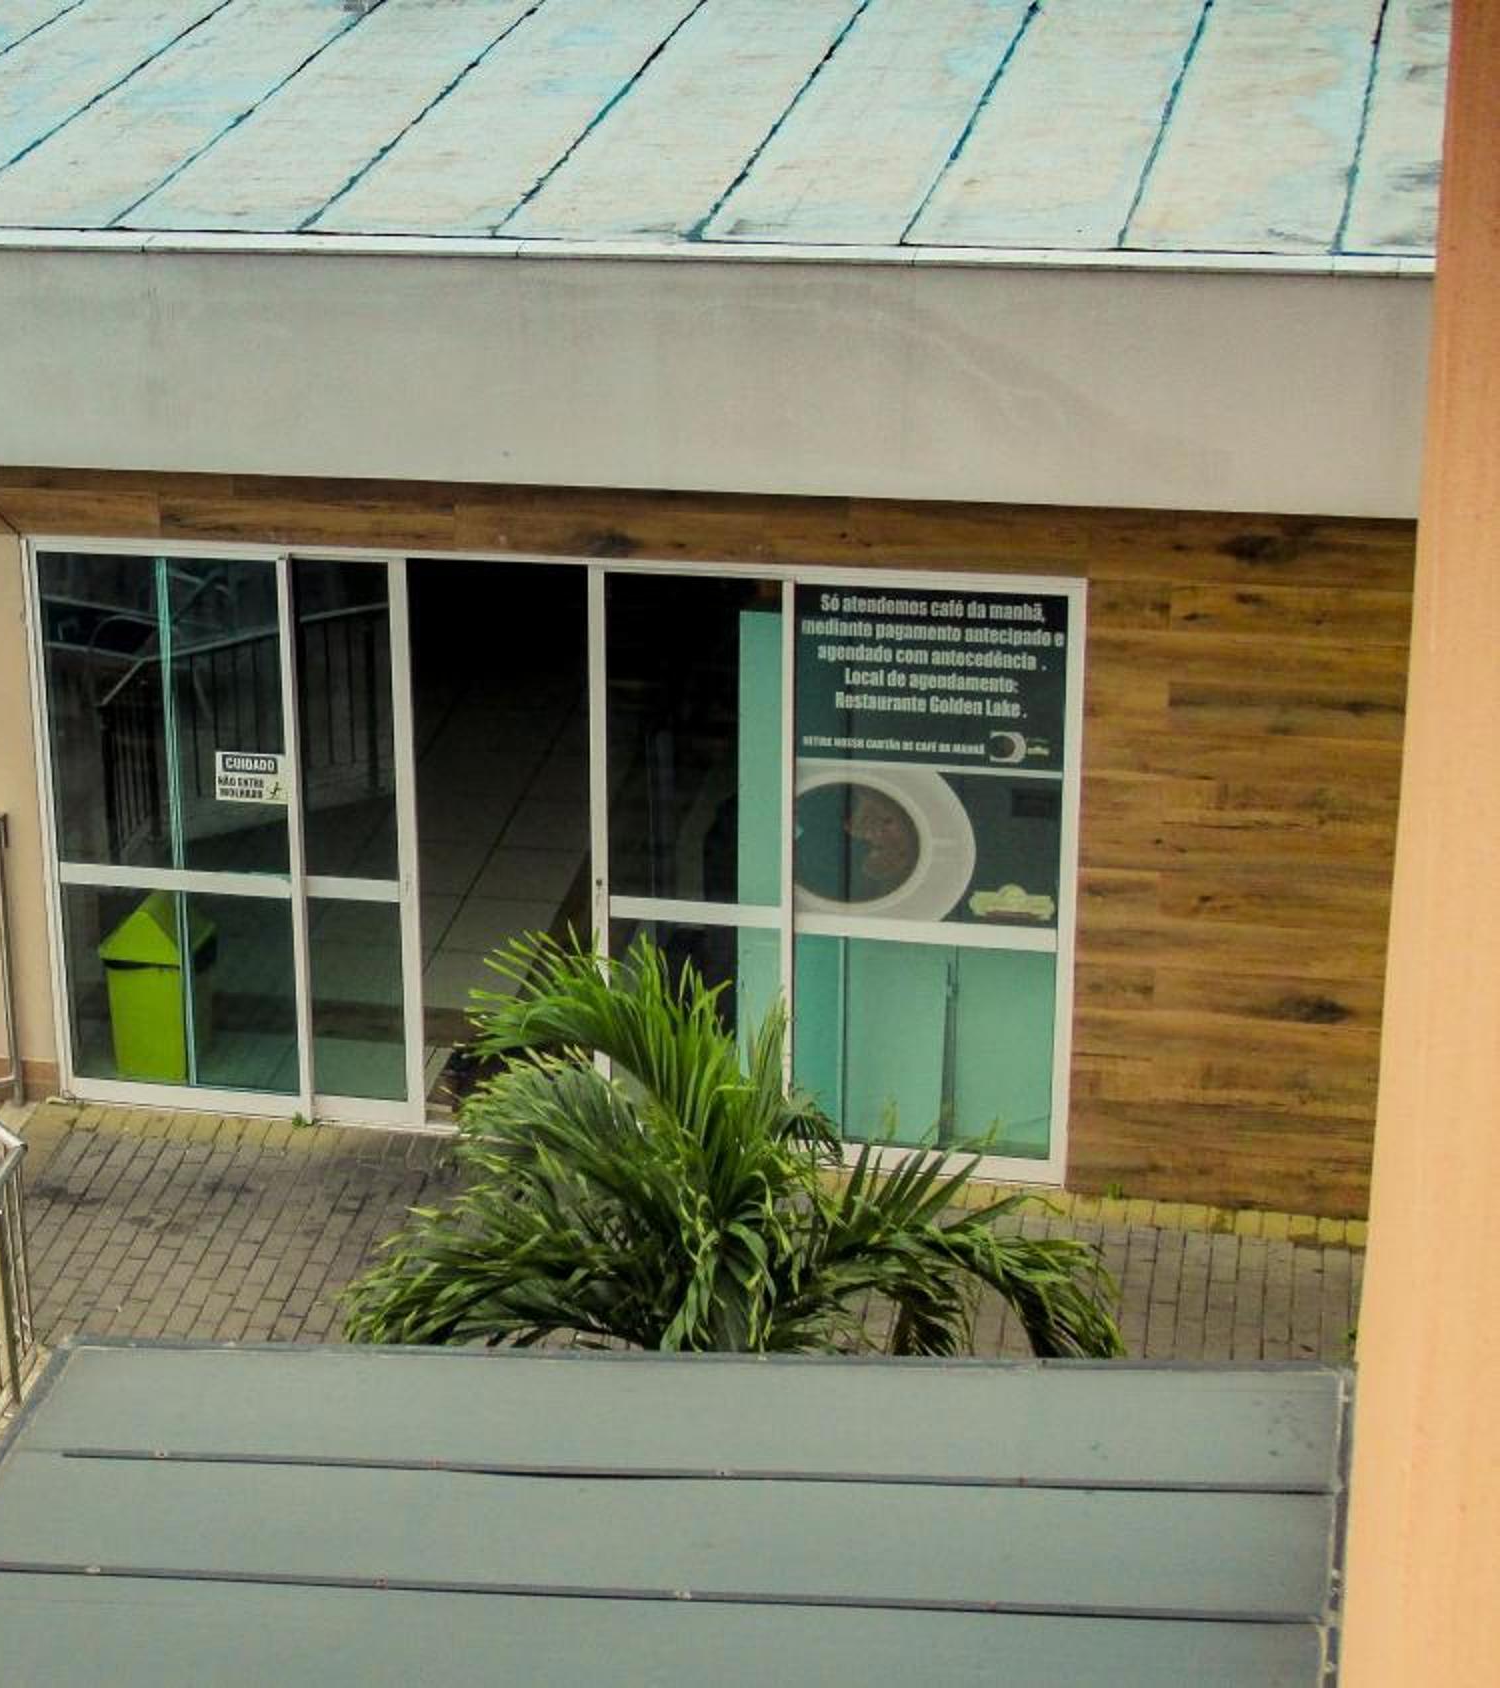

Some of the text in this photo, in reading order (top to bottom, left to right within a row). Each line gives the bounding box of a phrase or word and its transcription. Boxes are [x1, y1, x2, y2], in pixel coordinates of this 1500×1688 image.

[820, 593, 1045, 623] Só atendemos café da manhã,
[801, 618, 1064, 647] mediante pagamento antecipado e
[817, 643, 892, 662] agendado
[895, 648, 929, 665] com
[931, 649, 1037, 671] antecedência
[845, 666, 1019, 694] Local de agendamento:
[835, 691, 927, 712] Restaurante
[929, 695, 983, 715] Golden
[985, 699, 1020, 718] Lake
[225, 757, 275, 772] CUIDADO
